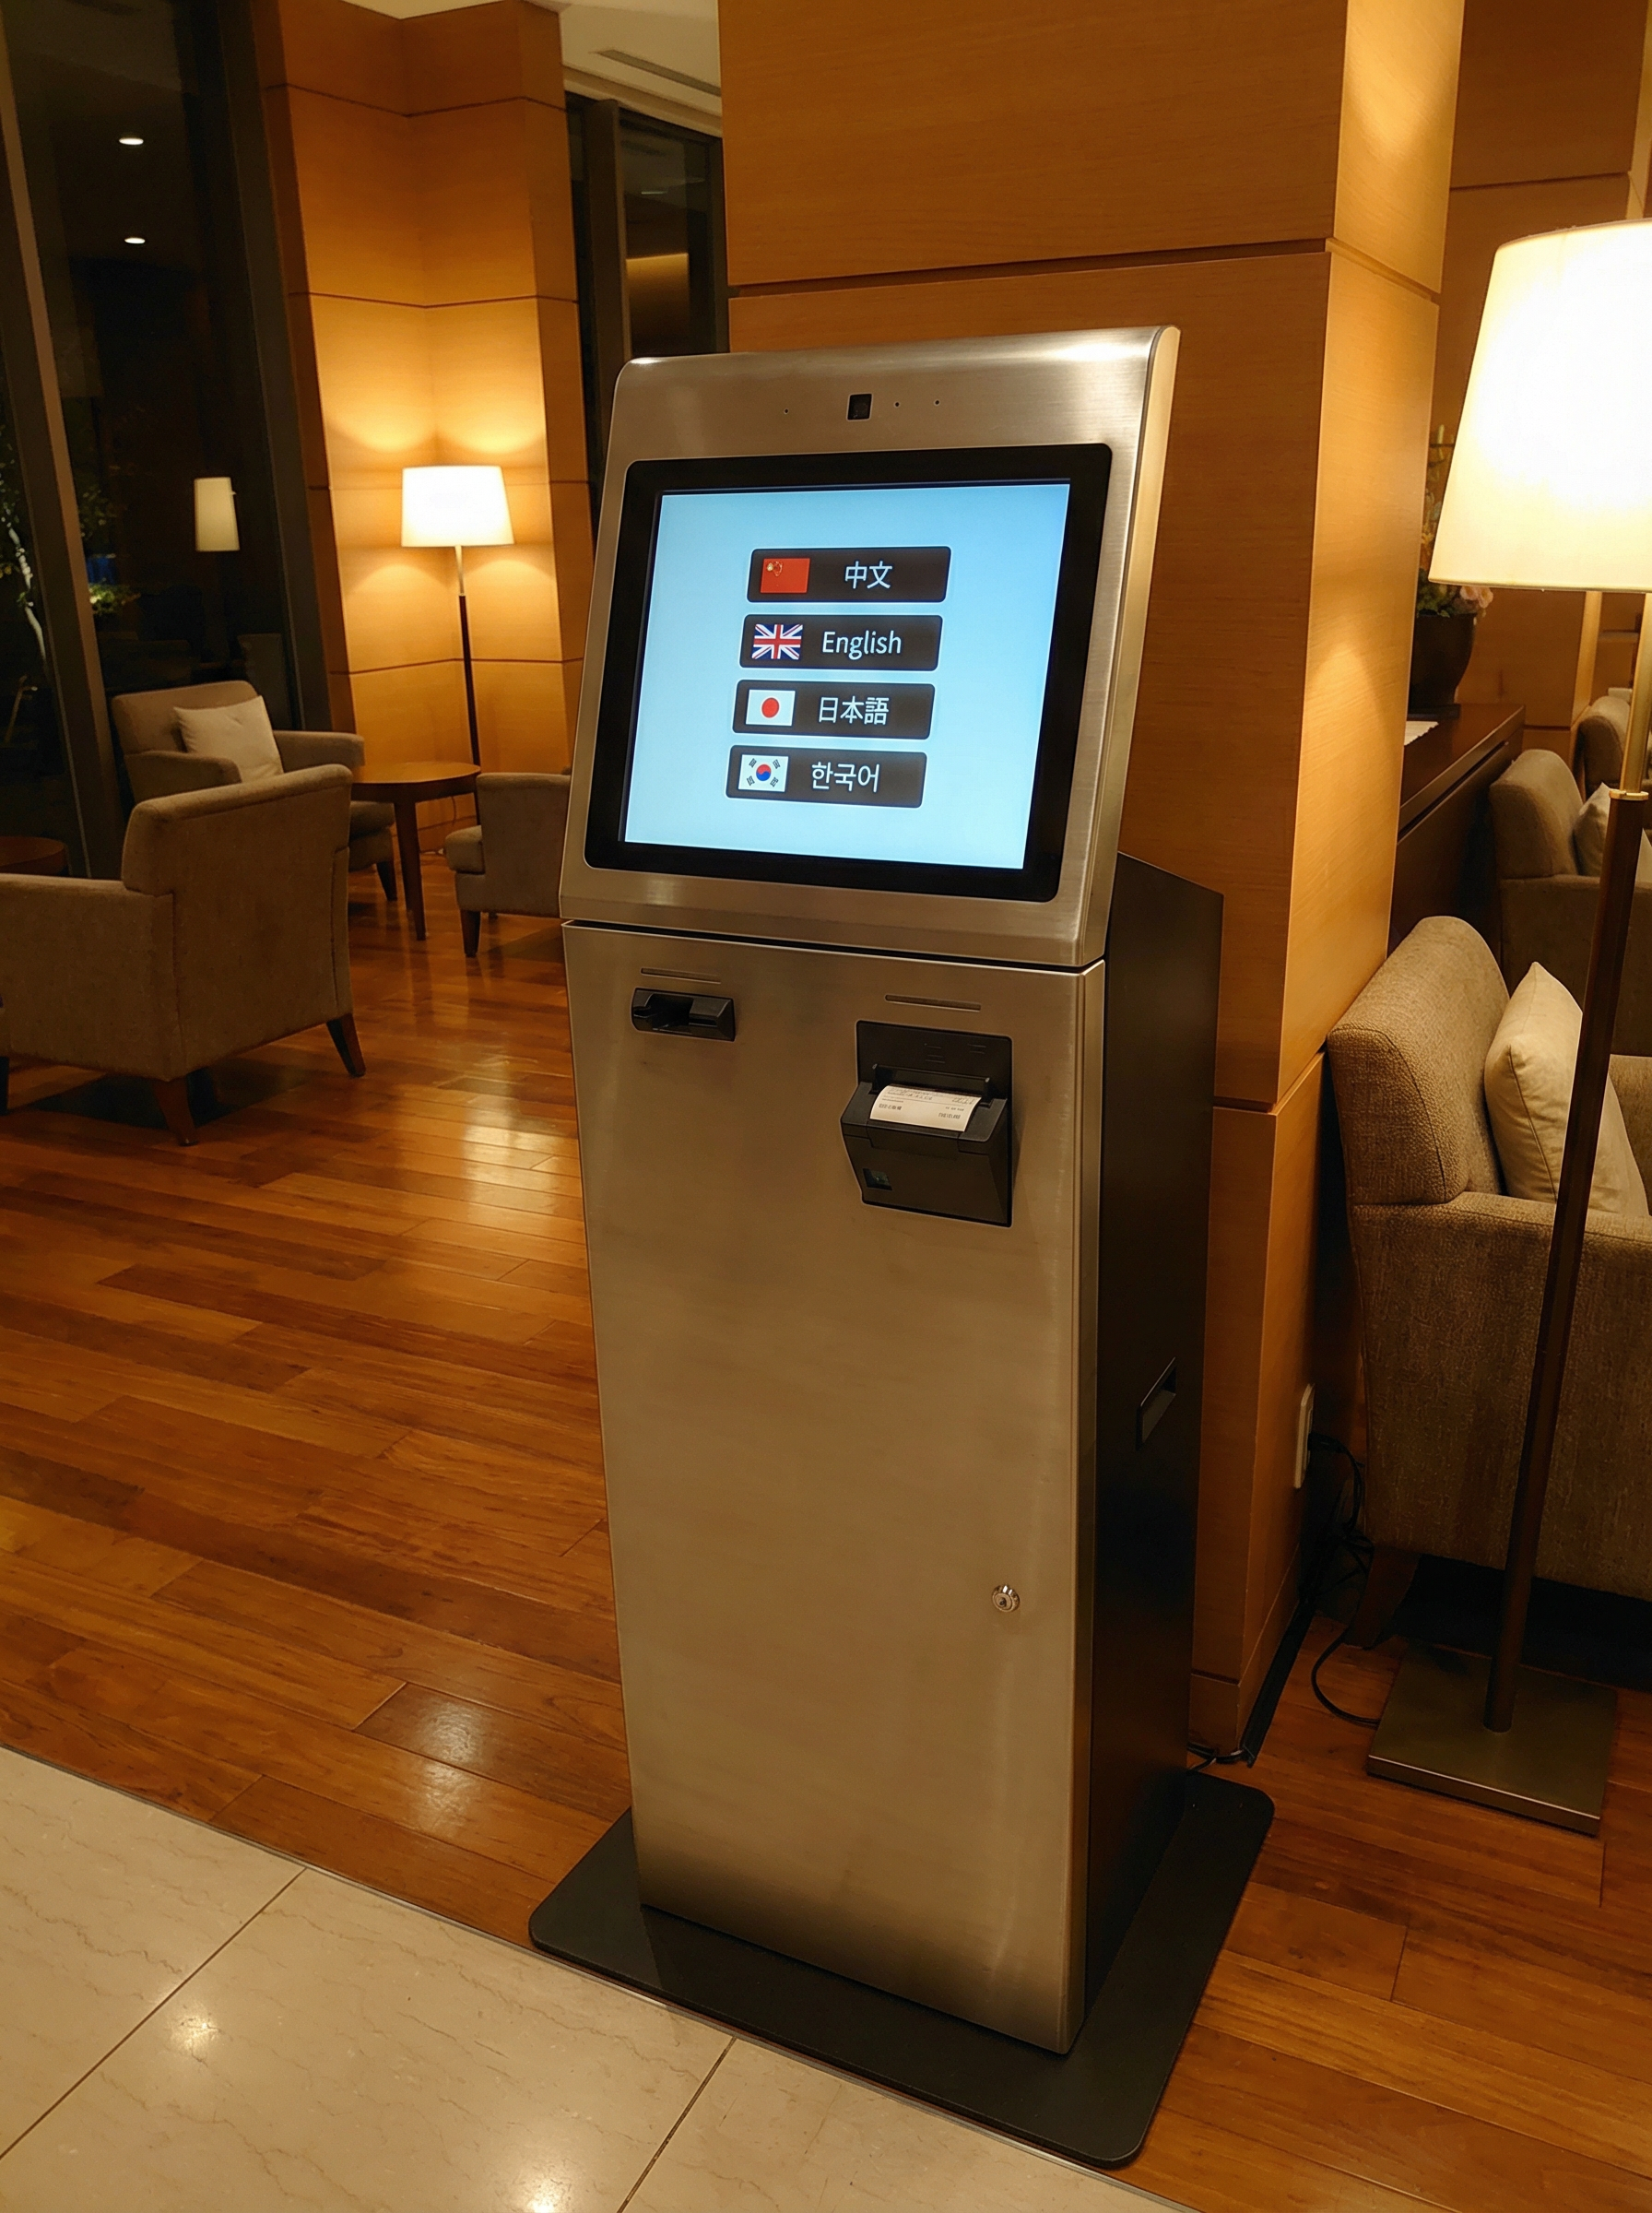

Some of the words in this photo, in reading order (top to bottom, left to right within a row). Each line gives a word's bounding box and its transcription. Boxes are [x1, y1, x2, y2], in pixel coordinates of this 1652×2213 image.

[844, 560, 893, 589] 中文
[821, 630, 902, 660] English
[819, 695, 890, 726] 日本語
[811, 761, 880, 793] 한국어
